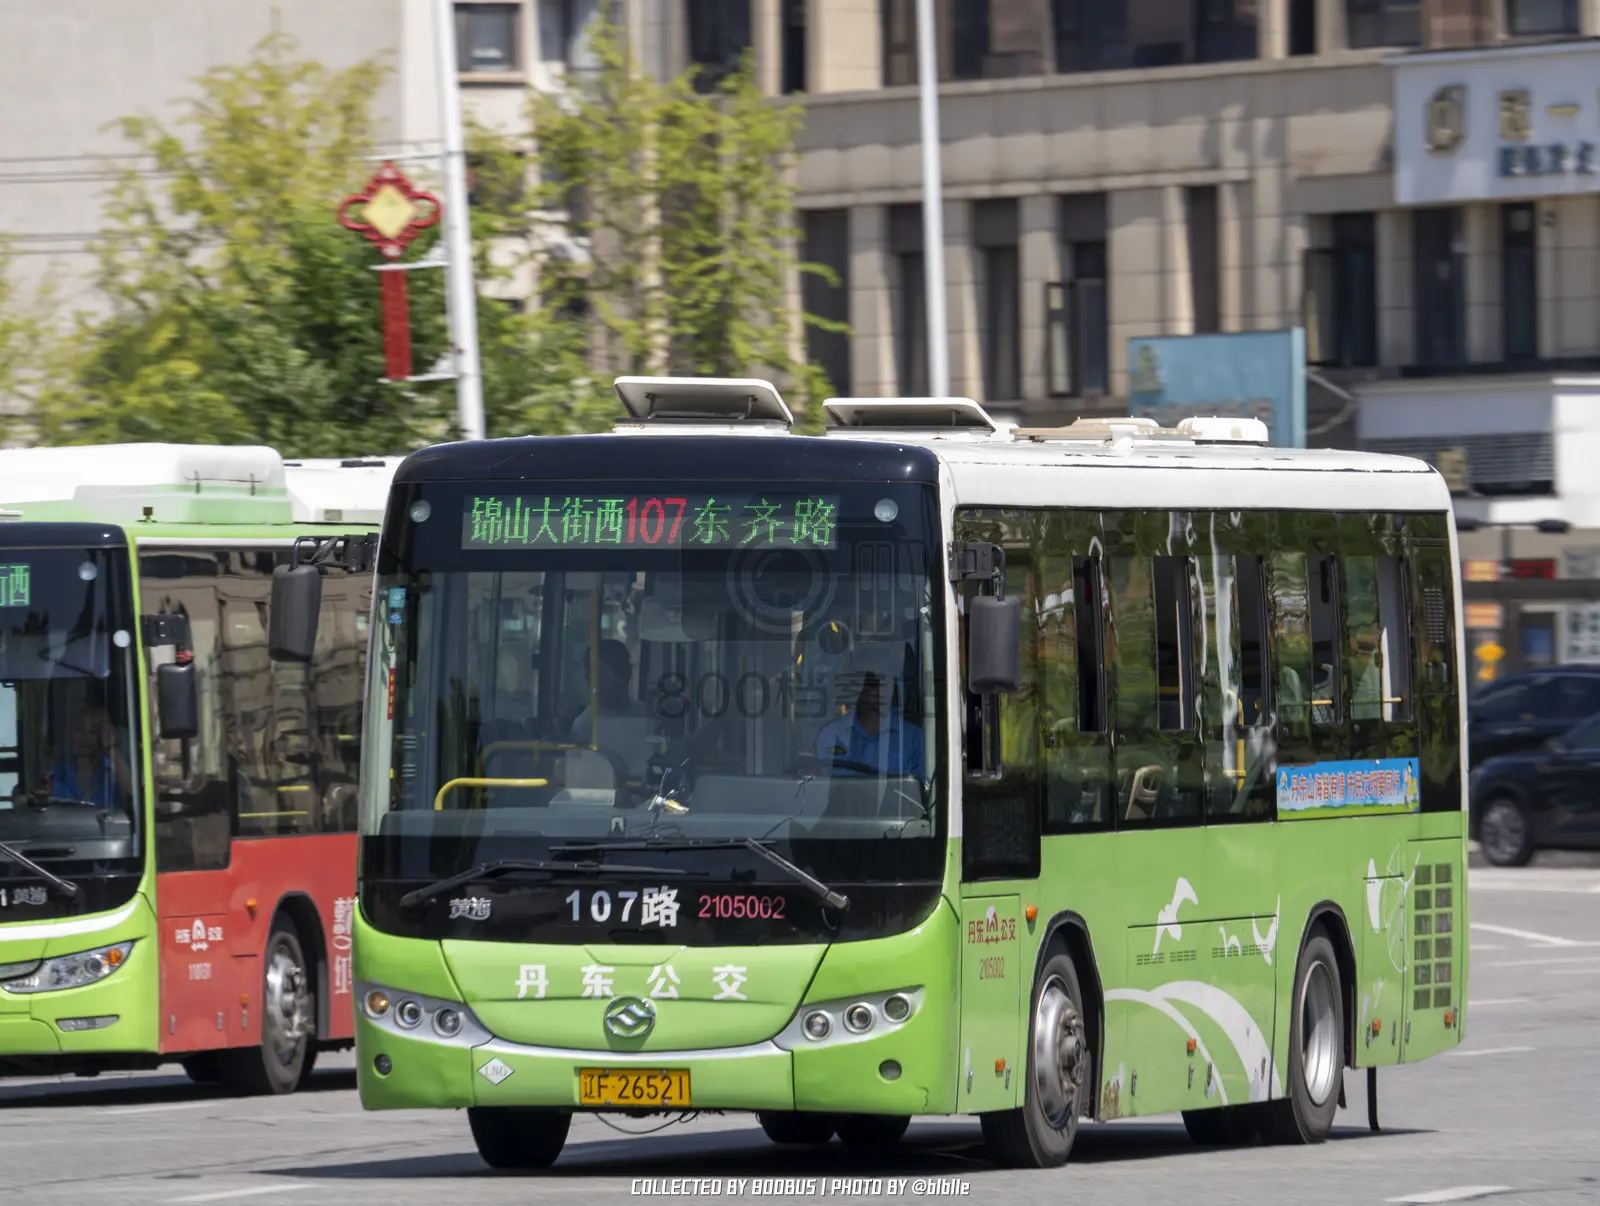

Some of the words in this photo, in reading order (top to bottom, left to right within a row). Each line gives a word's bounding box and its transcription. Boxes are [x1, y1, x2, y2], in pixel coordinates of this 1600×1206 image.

[471, 497, 624, 545] 锦山大街西
[626, 498, 686, 544] 107
[689, 497, 836, 546] 东齐路
[449, 897, 492, 921] 黄海
[565, 885, 681, 927] 107路
[698, 895, 786, 919] 2105002
[968, 920, 983, 943] 丹东
[1001, 917, 1016, 941] 公交
[515, 964, 747, 999] 丹东公交
